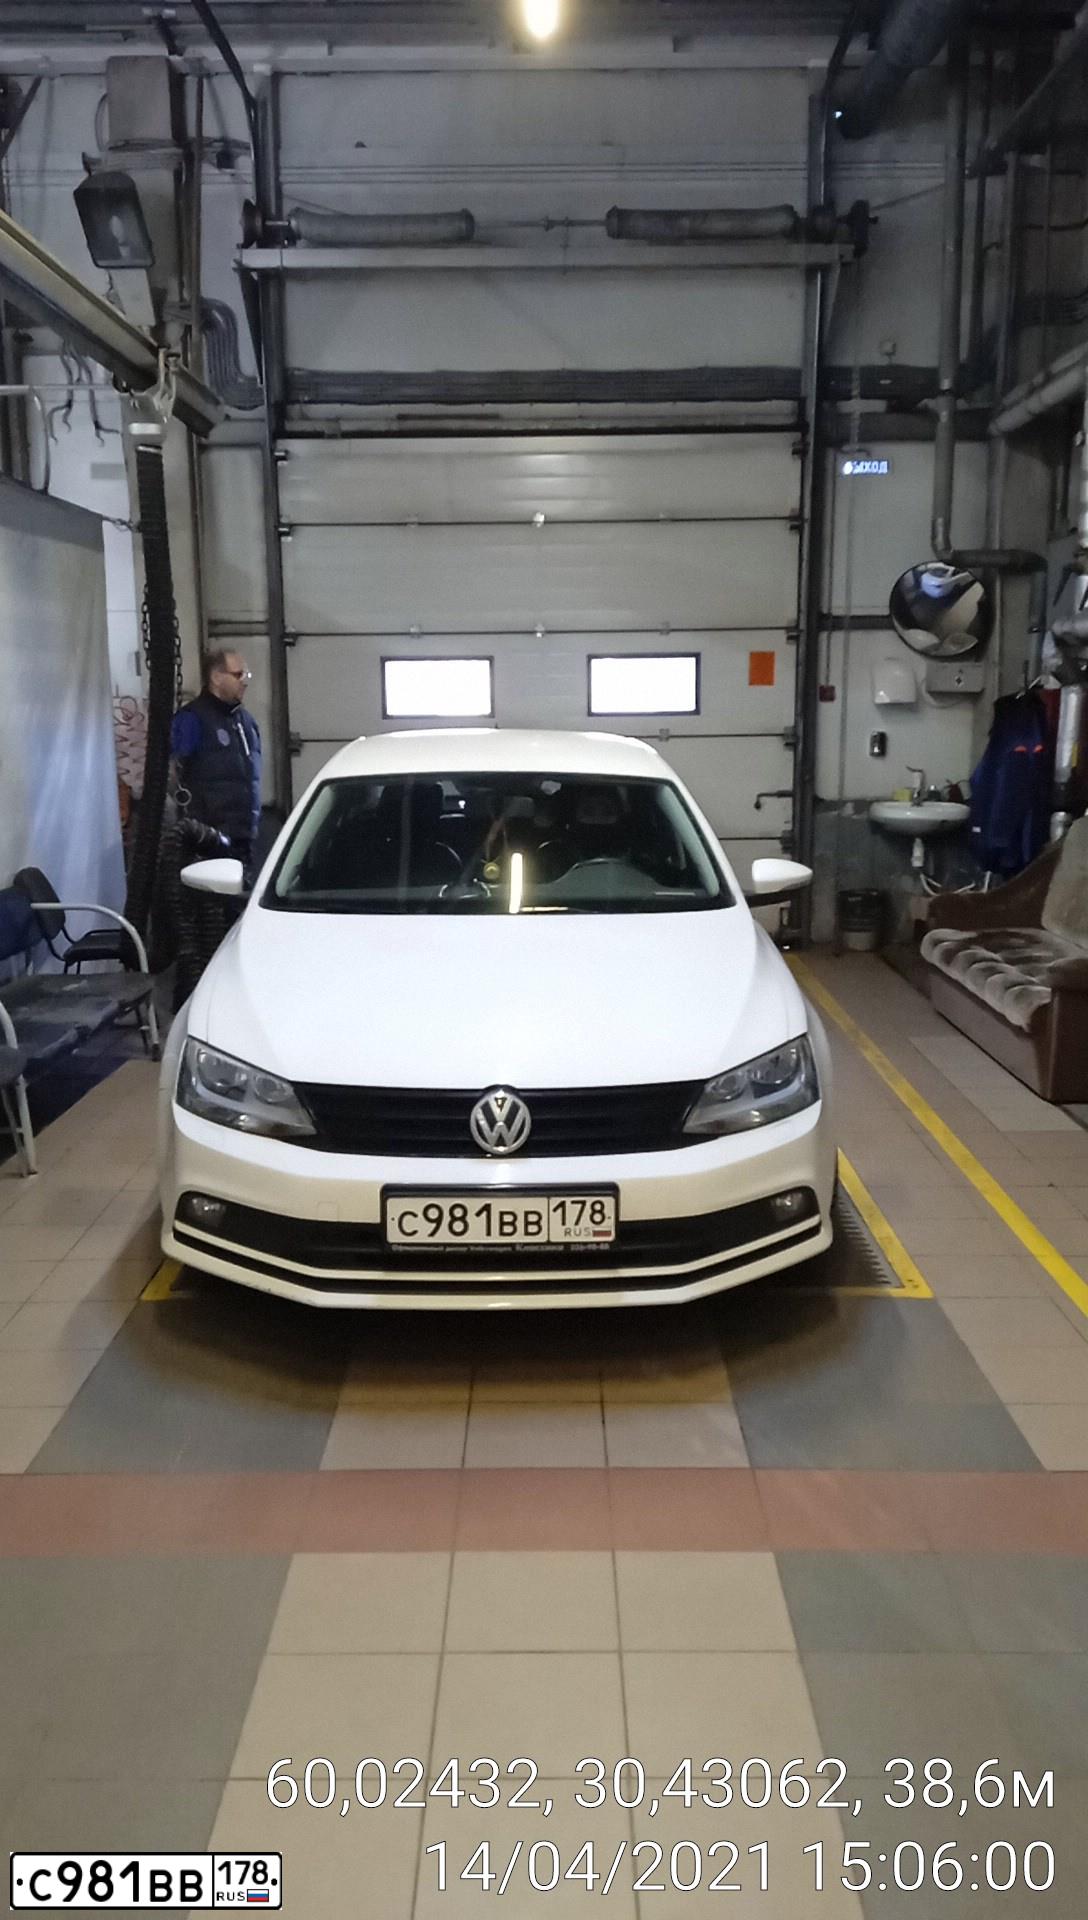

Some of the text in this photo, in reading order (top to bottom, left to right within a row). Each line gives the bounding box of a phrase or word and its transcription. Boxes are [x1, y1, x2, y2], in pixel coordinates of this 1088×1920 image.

[843, 460, 888, 475] ЫХОД
[552, 1199, 606, 1227] 178
[564, 1227, 591, 1238] RUS
